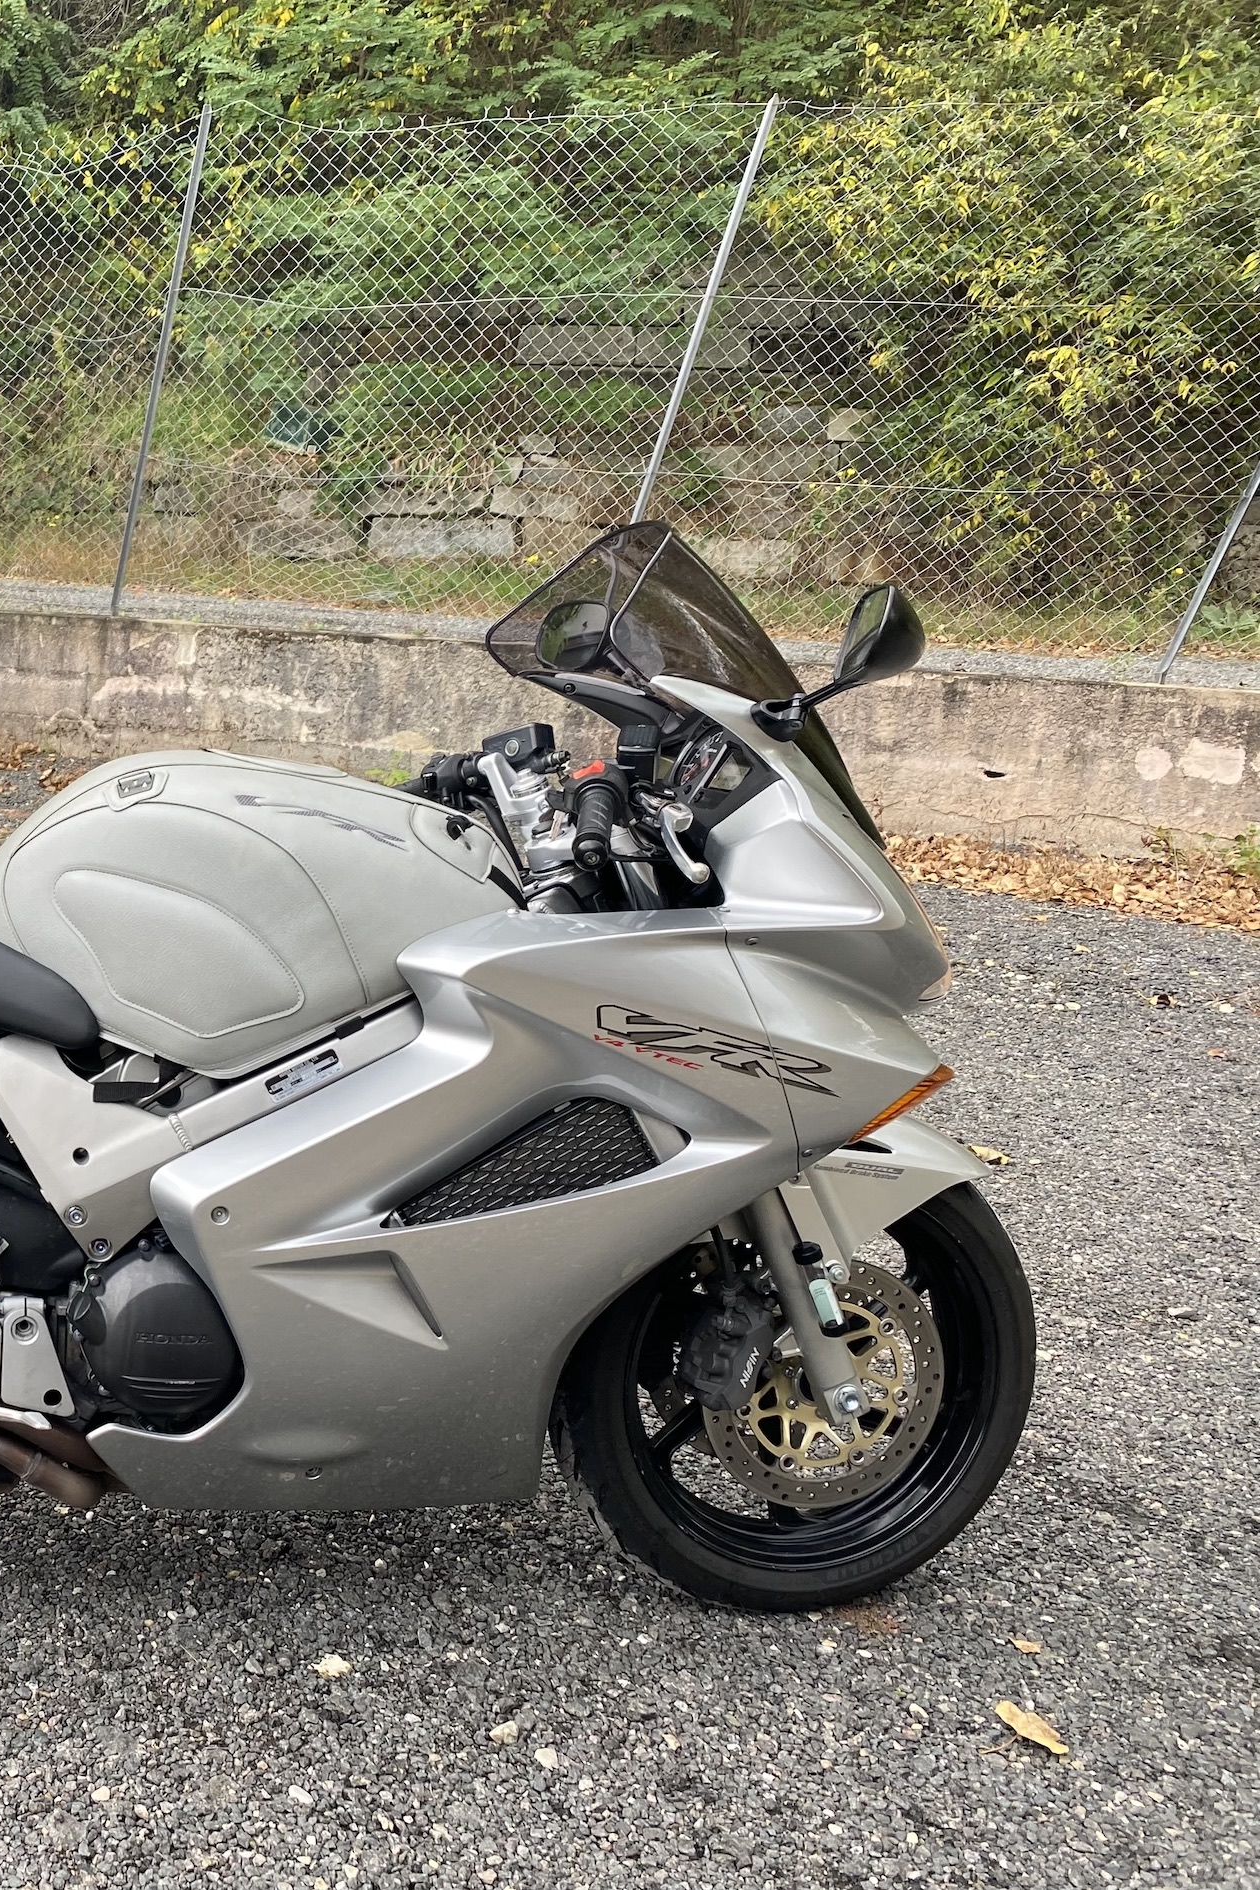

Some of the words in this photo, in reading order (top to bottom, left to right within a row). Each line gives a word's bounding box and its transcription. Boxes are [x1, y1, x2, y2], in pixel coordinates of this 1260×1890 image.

[593, 1033, 625, 1048] V4
[635, 1046, 704, 1071] VTEC
[596, 1004, 841, 1099] VFR
[136, 1332, 214, 1346] HONDA
